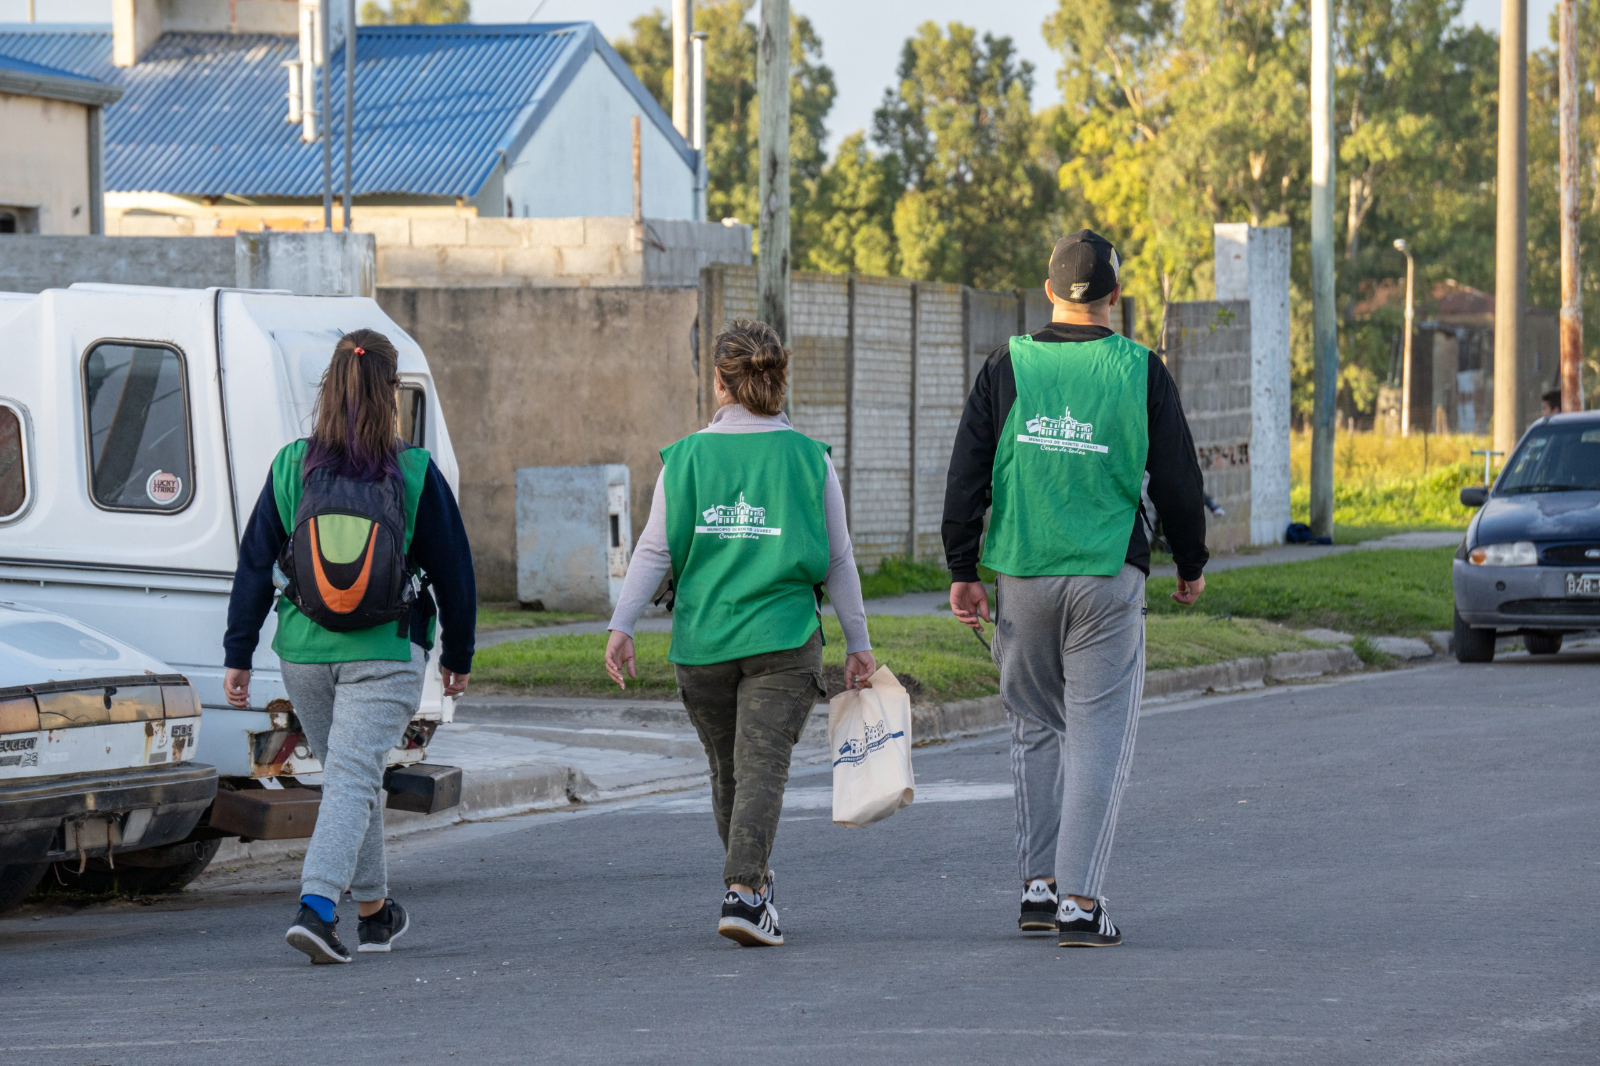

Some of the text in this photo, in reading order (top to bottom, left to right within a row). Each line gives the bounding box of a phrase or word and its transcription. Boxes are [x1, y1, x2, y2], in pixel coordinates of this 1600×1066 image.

[1070, 282, 1090, 299] 7
[1028, 437, 1053, 445] MUNICIPIO
[1061, 440, 1079, 448] BENITO
[1068, 447, 1086, 455] todos
[153, 485, 176, 493] STRIKE
